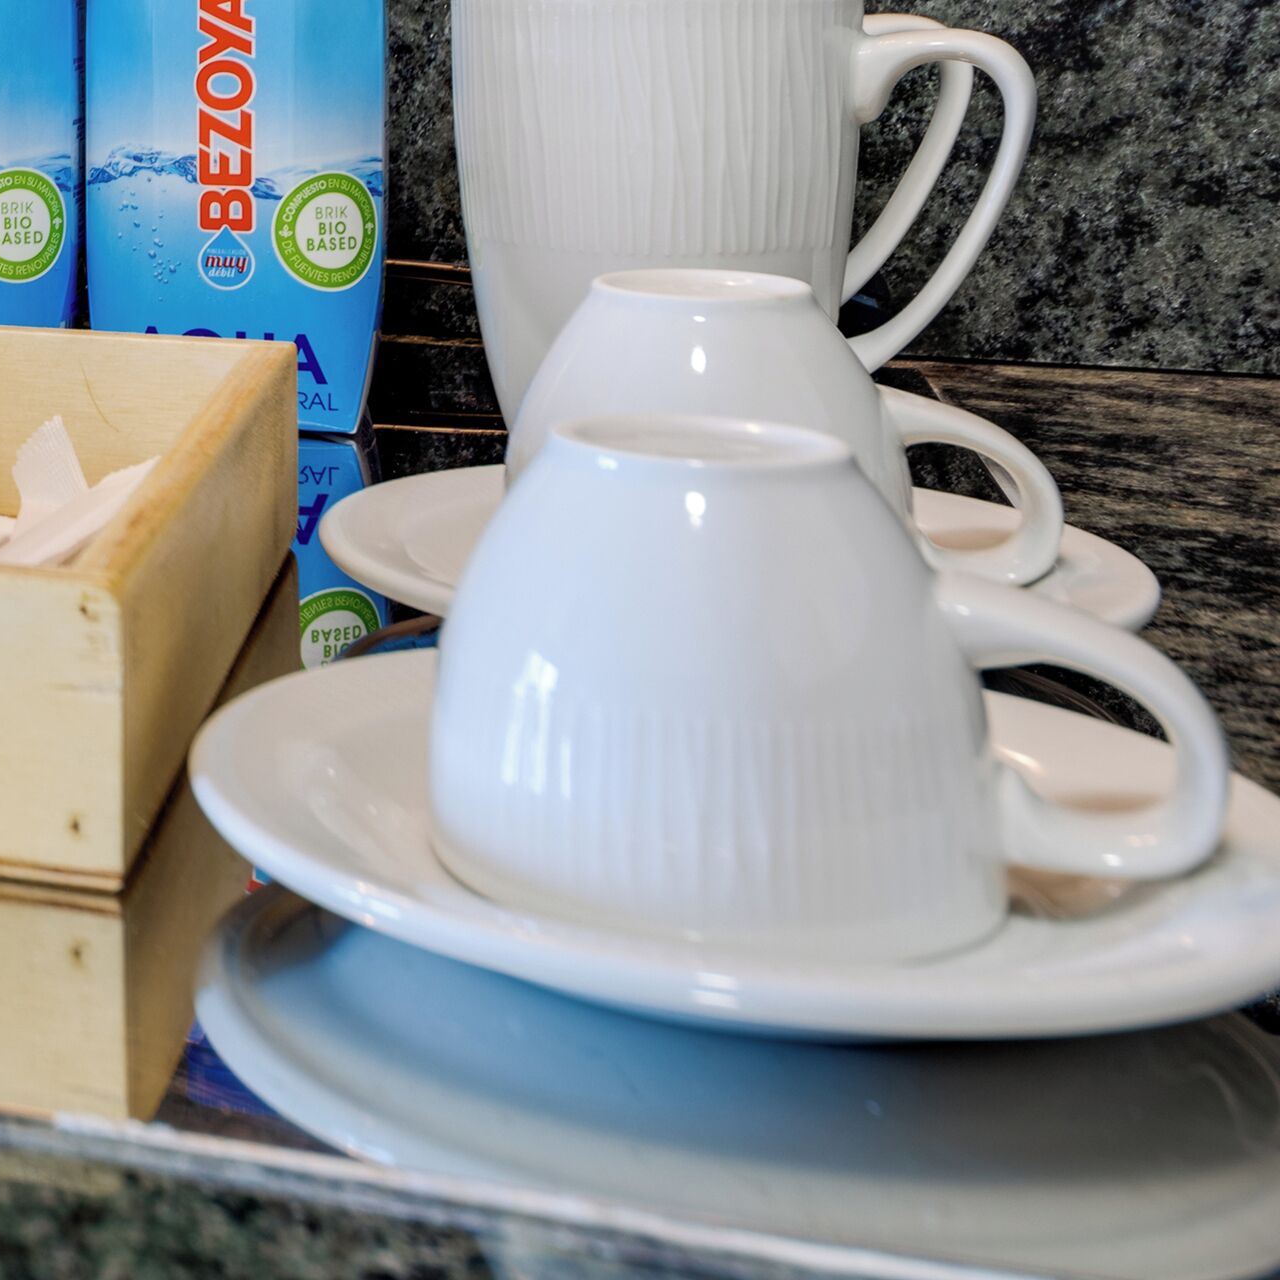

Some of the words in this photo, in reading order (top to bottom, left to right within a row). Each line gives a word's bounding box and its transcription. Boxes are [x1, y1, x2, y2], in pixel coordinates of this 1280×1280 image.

[1, 201, 34, 215] BRIK
[315, 205, 348, 219] BRIK
[4, 216, 32, 230] BIO
[319, 221, 347, 236] BIO
[282, 240, 294, 255] DE
[306, 236, 357, 251] BASED
[205, 255, 248, 273] muy
